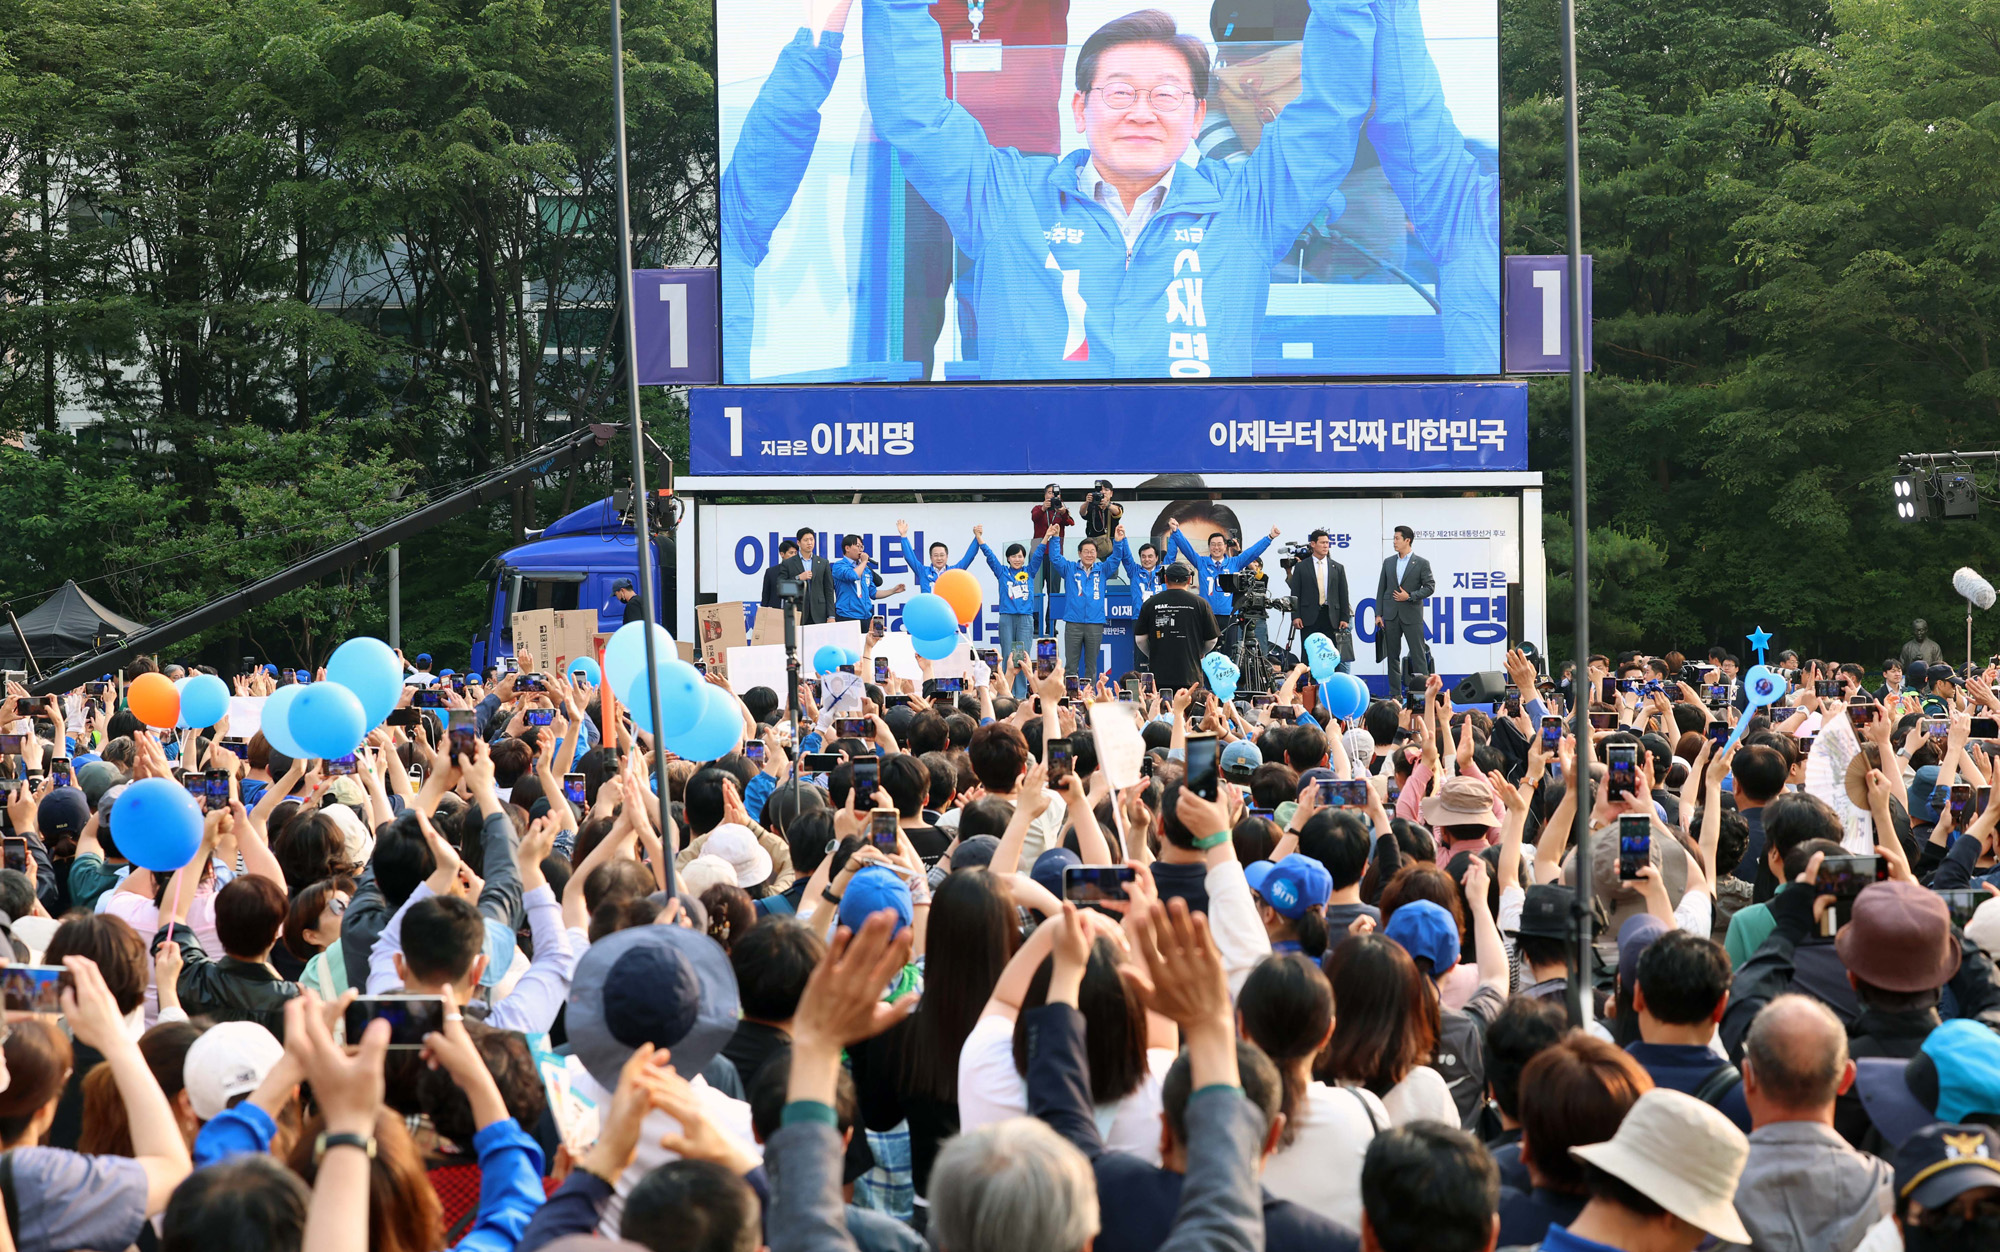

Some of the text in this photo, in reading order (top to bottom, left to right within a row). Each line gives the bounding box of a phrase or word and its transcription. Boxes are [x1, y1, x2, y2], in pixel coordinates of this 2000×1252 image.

[660, 283, 688, 368] 1
[1533, 270, 1561, 355] 1
[724, 407, 914, 457] 1 지금은 이재명
[1209, 418, 1507, 453] 이제부터 진짜 대한민국
[1436, 530, 1458, 538] 제21대
[1459, 530, 1492, 538] 대통령선거
[1453, 571, 1507, 590] 지금은
[1111, 605, 1133, 616] 이재
